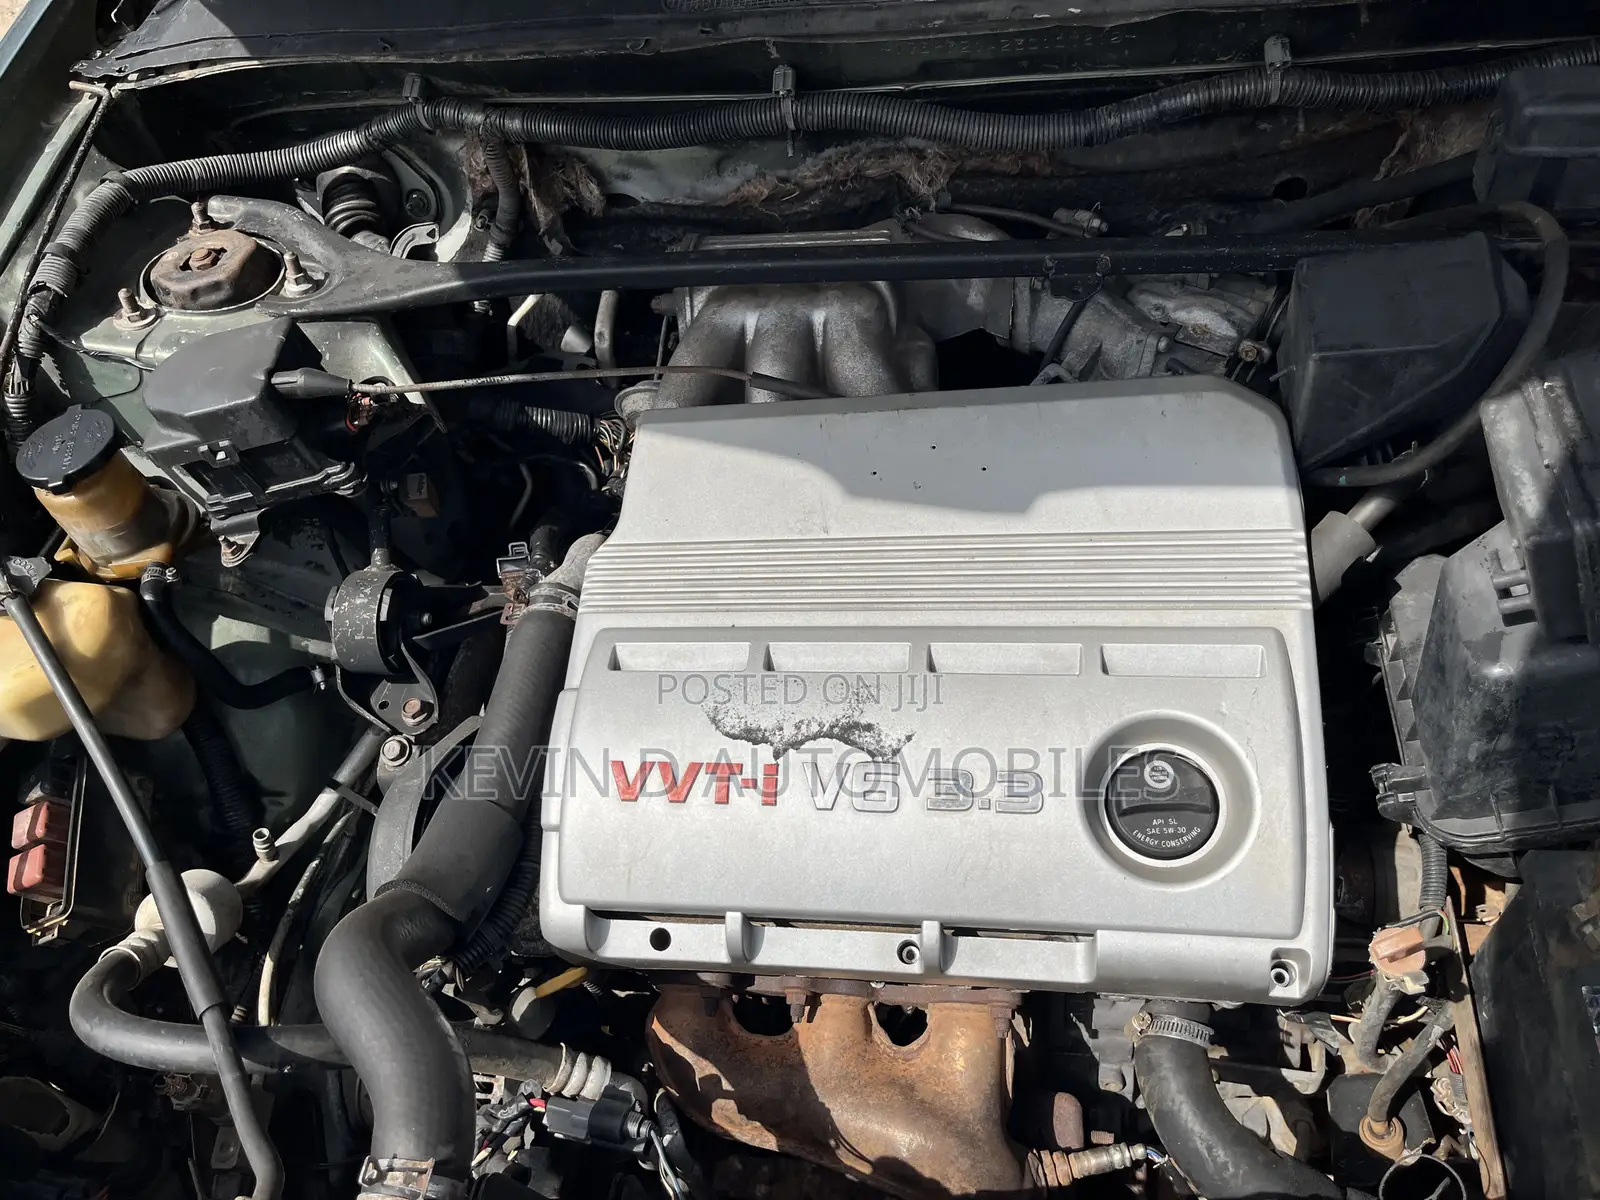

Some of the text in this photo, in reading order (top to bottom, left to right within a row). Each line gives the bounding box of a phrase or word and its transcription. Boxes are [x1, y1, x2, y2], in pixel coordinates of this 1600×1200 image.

[610, 760, 1044, 814] VVT-i V6 3.3
[1152, 818, 1165, 826] API
[1132, 827, 1201, 848] ENERGY CONSERVING
[1163, 826, 1187, 835] 5W-30
